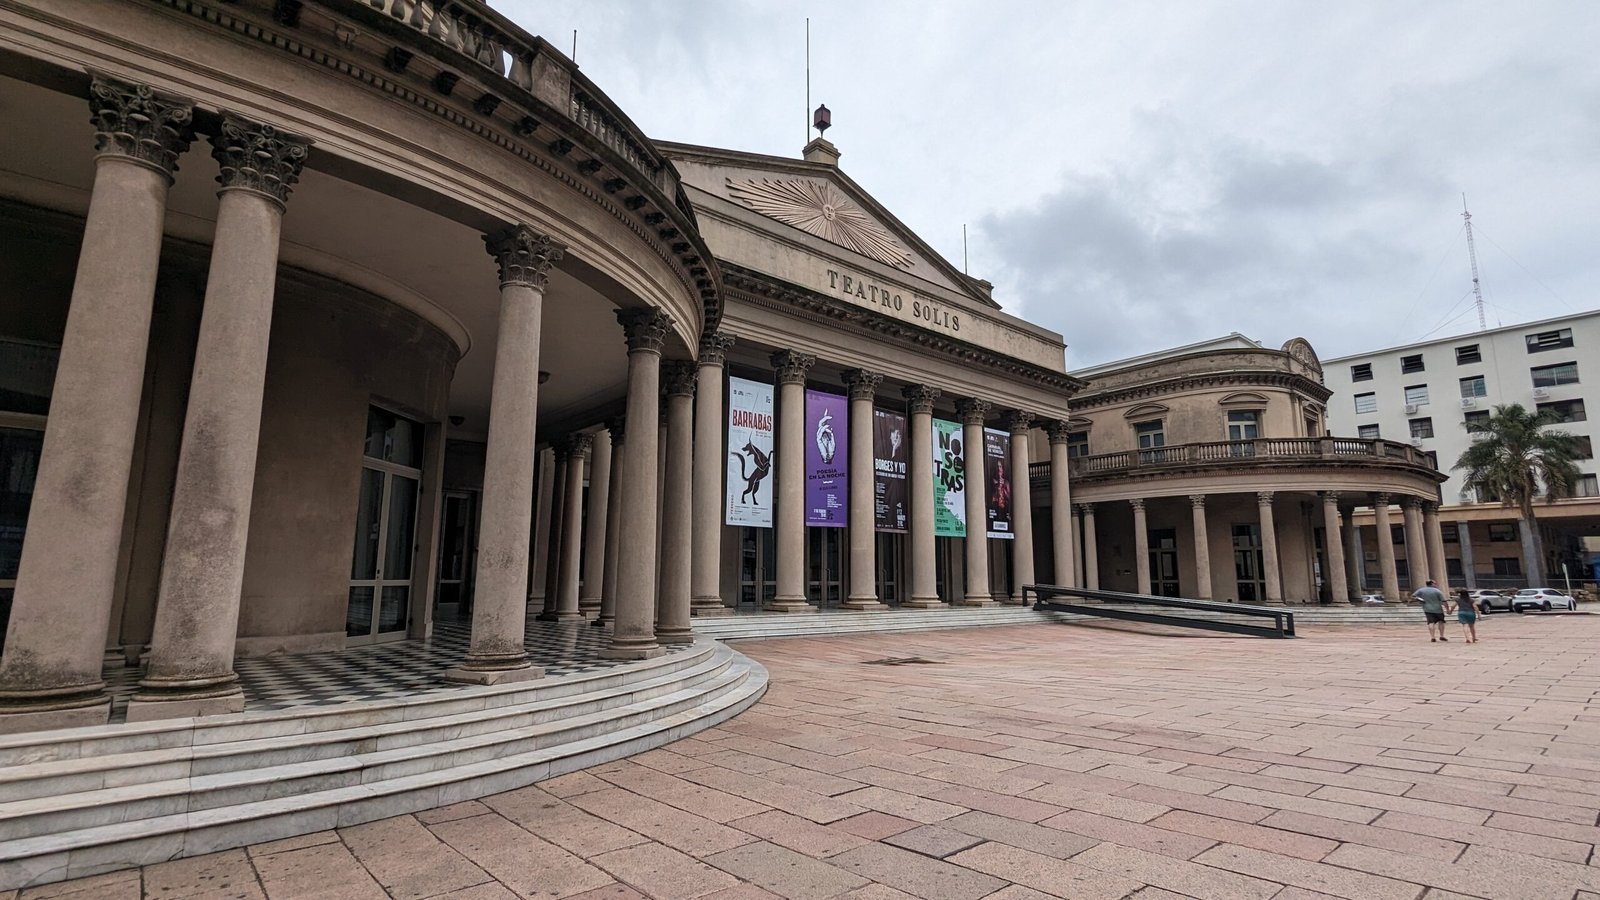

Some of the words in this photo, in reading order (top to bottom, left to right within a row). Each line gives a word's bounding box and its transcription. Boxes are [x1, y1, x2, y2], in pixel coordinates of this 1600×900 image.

[827, 269, 902, 311] TEATRO
[913, 301, 960, 331] SOLIS
[874, 458, 893, 472] BORGES
[894, 461, 898, 473] Y
[899, 462, 906, 474] YO
